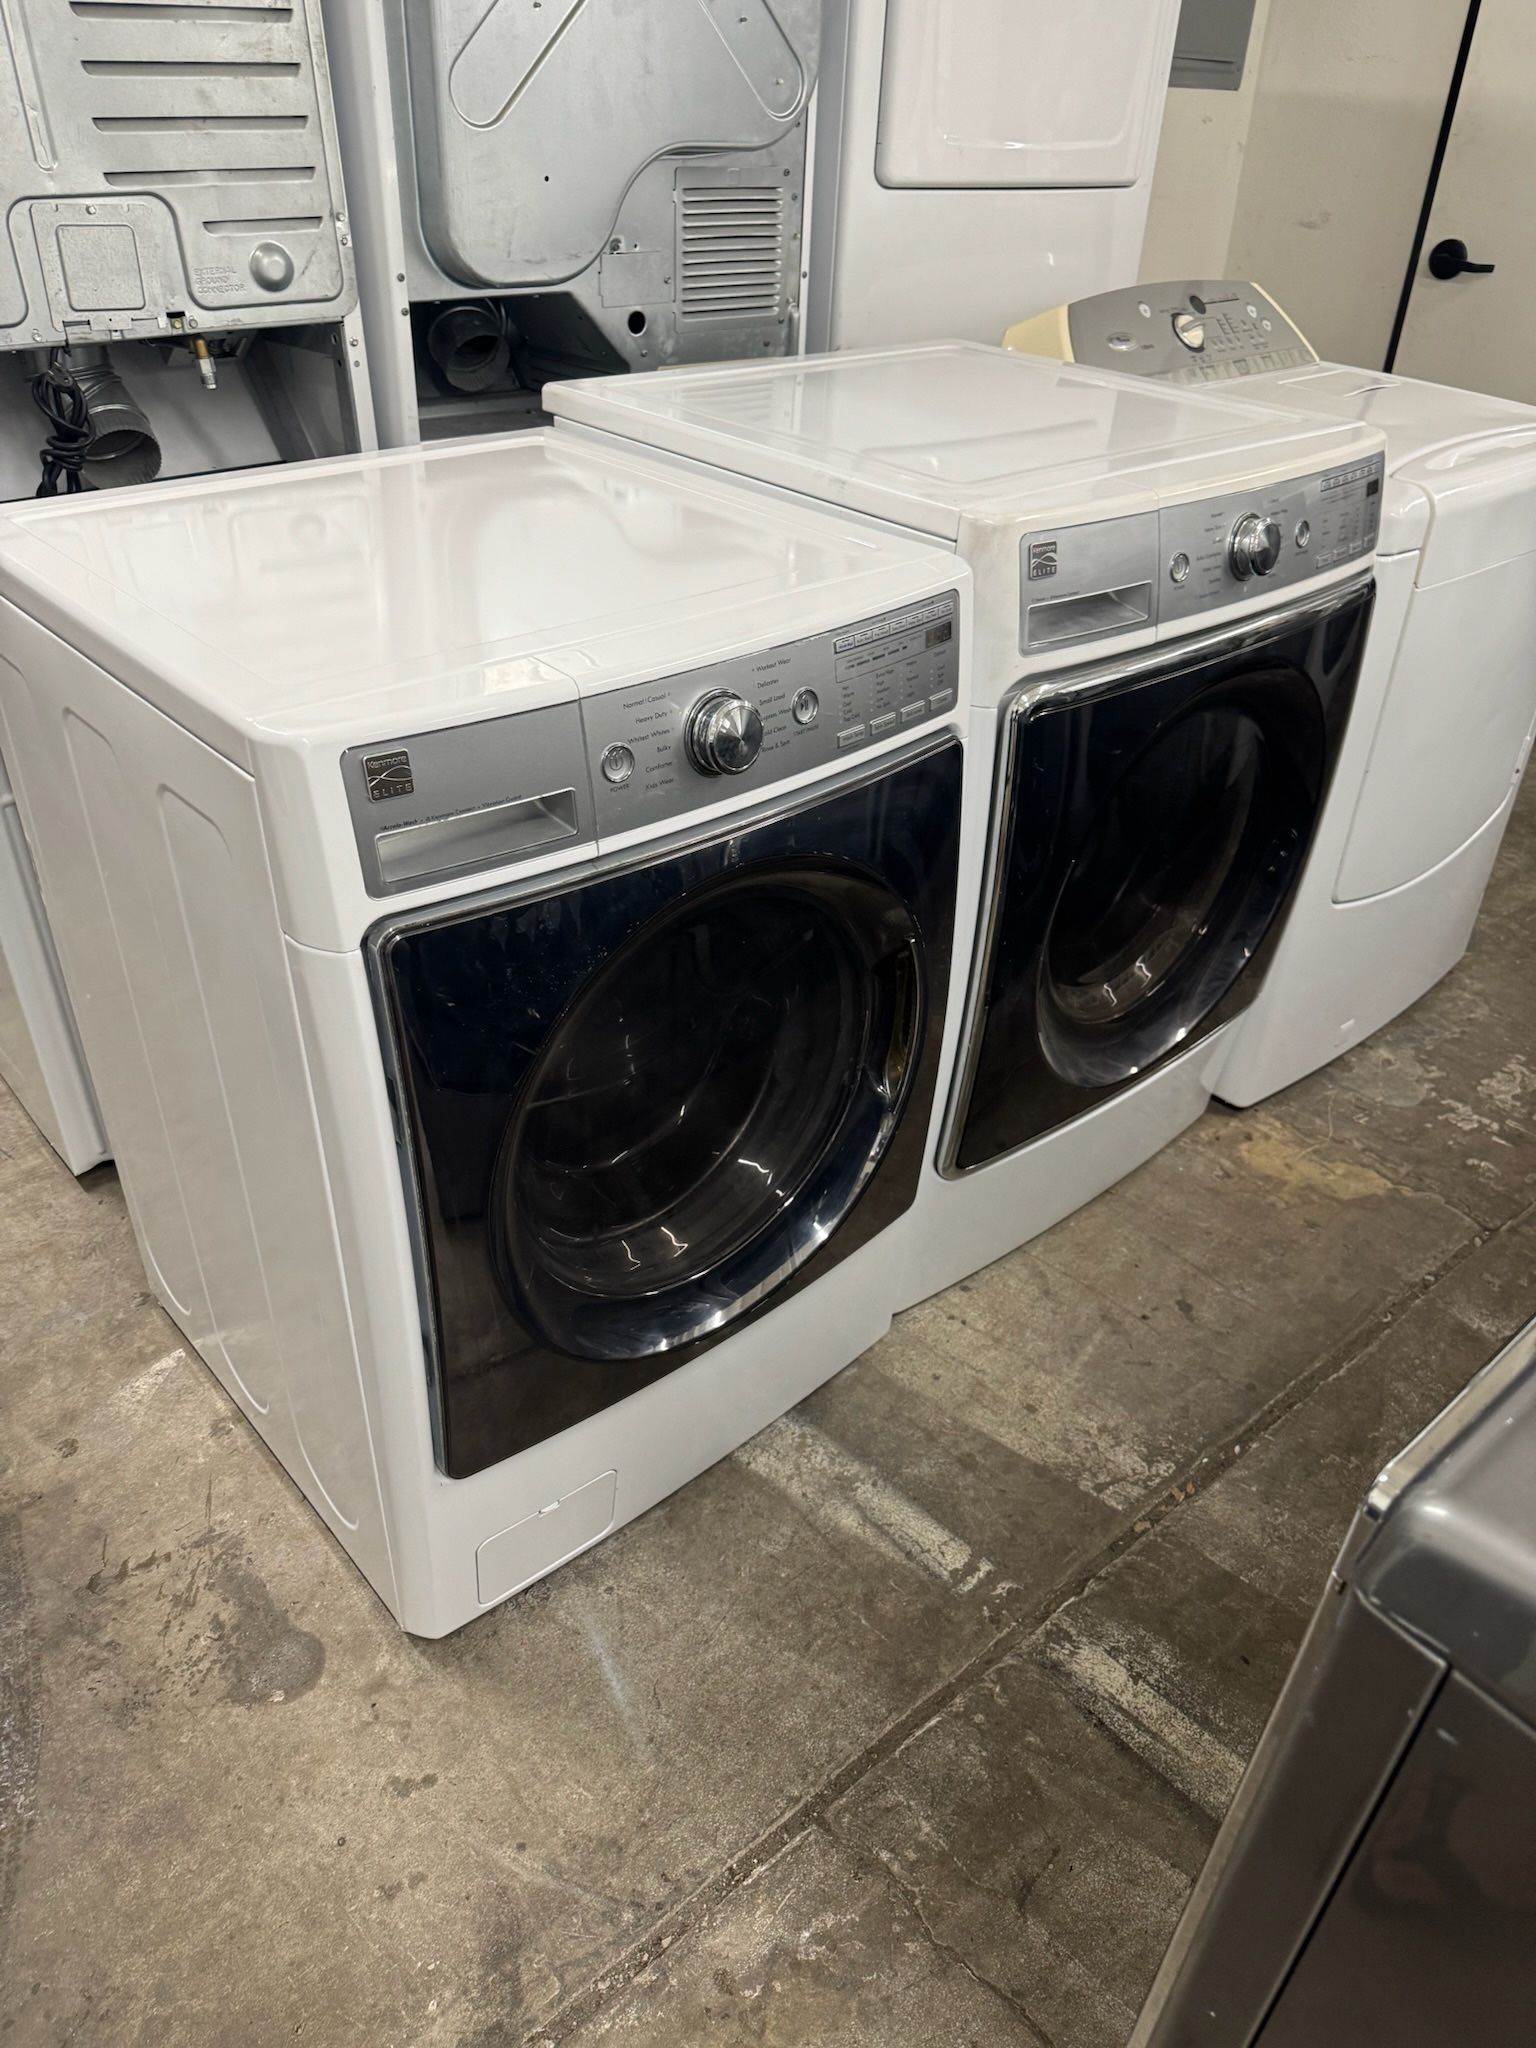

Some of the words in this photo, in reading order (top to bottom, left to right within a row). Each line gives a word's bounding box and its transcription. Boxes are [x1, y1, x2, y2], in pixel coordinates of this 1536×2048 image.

[1033, 566, 1056, 577] ELITE
[623, 698, 644, 709] Normal
[648, 692, 666, 703] Casual
[635, 715, 653, 725] Heavy
[655, 711, 668, 719] Duty
[657, 745, 671, 753] Bulky
[367, 755, 407, 769] Kenmore
[645, 761, 673, 773] Comforter
[372, 783, 413, 799] ELITE
[610, 783, 630, 793] POWER
